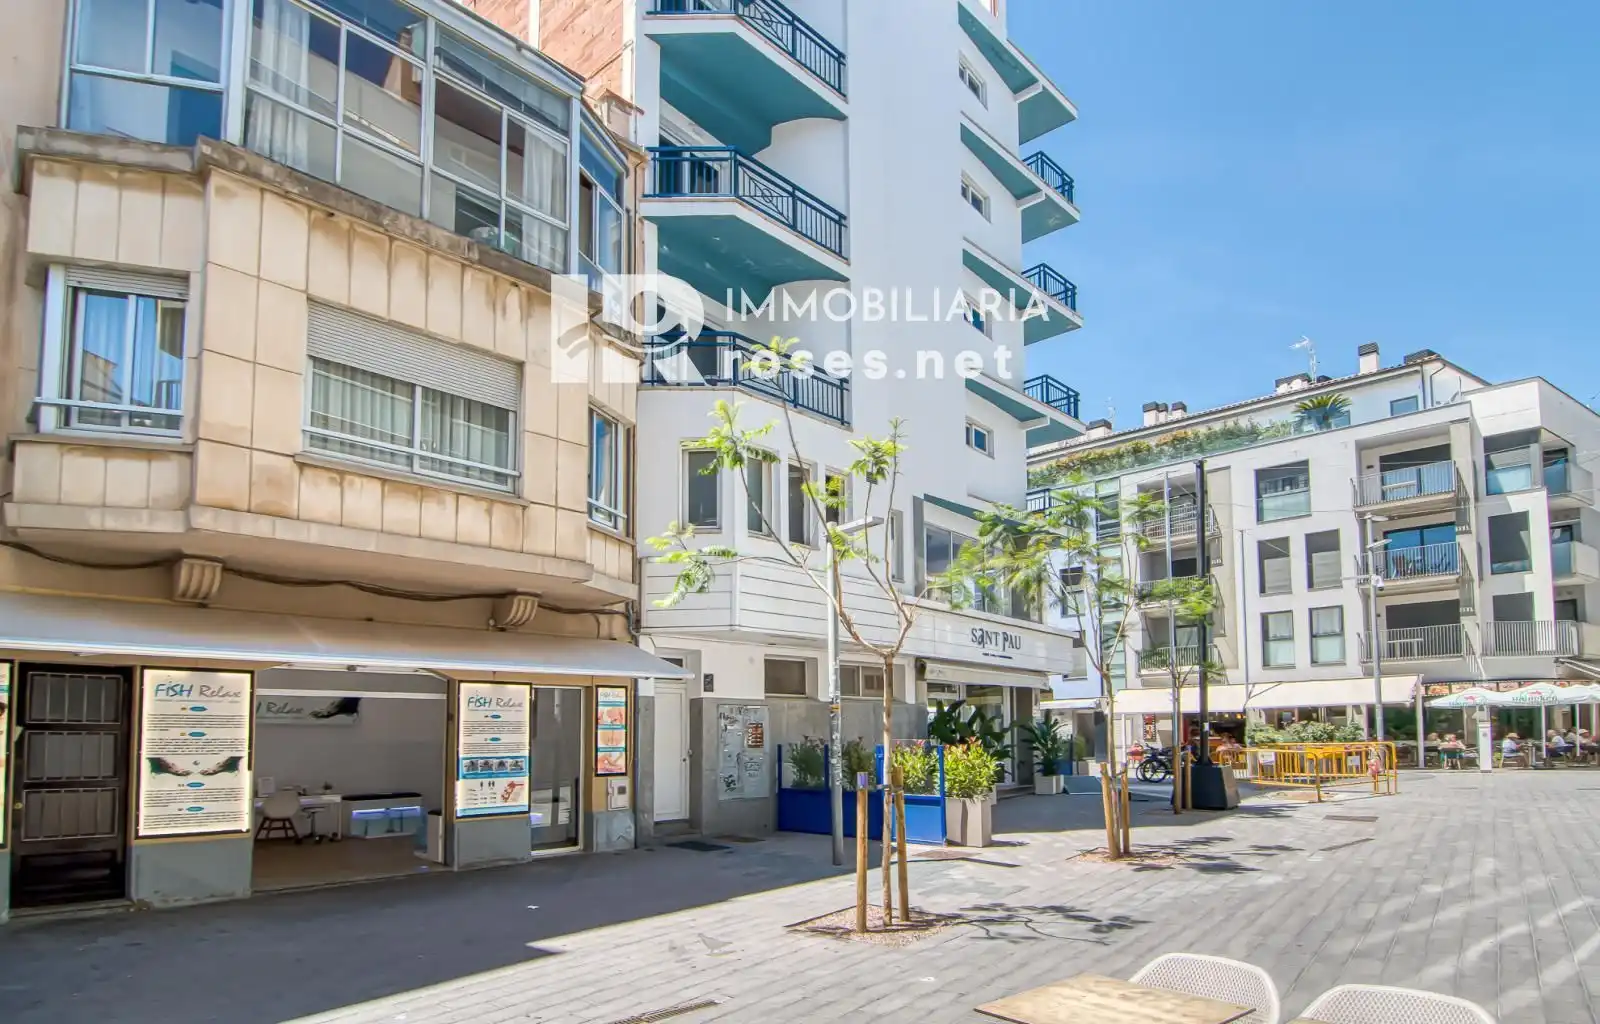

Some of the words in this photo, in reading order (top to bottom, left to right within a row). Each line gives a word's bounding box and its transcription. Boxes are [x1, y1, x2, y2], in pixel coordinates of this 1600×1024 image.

[1001, 631, 1021, 652] PAU
[198, 684, 241, 698] Relax
[266, 701, 304, 715] Relax
[496, 697, 524, 708] Relax
